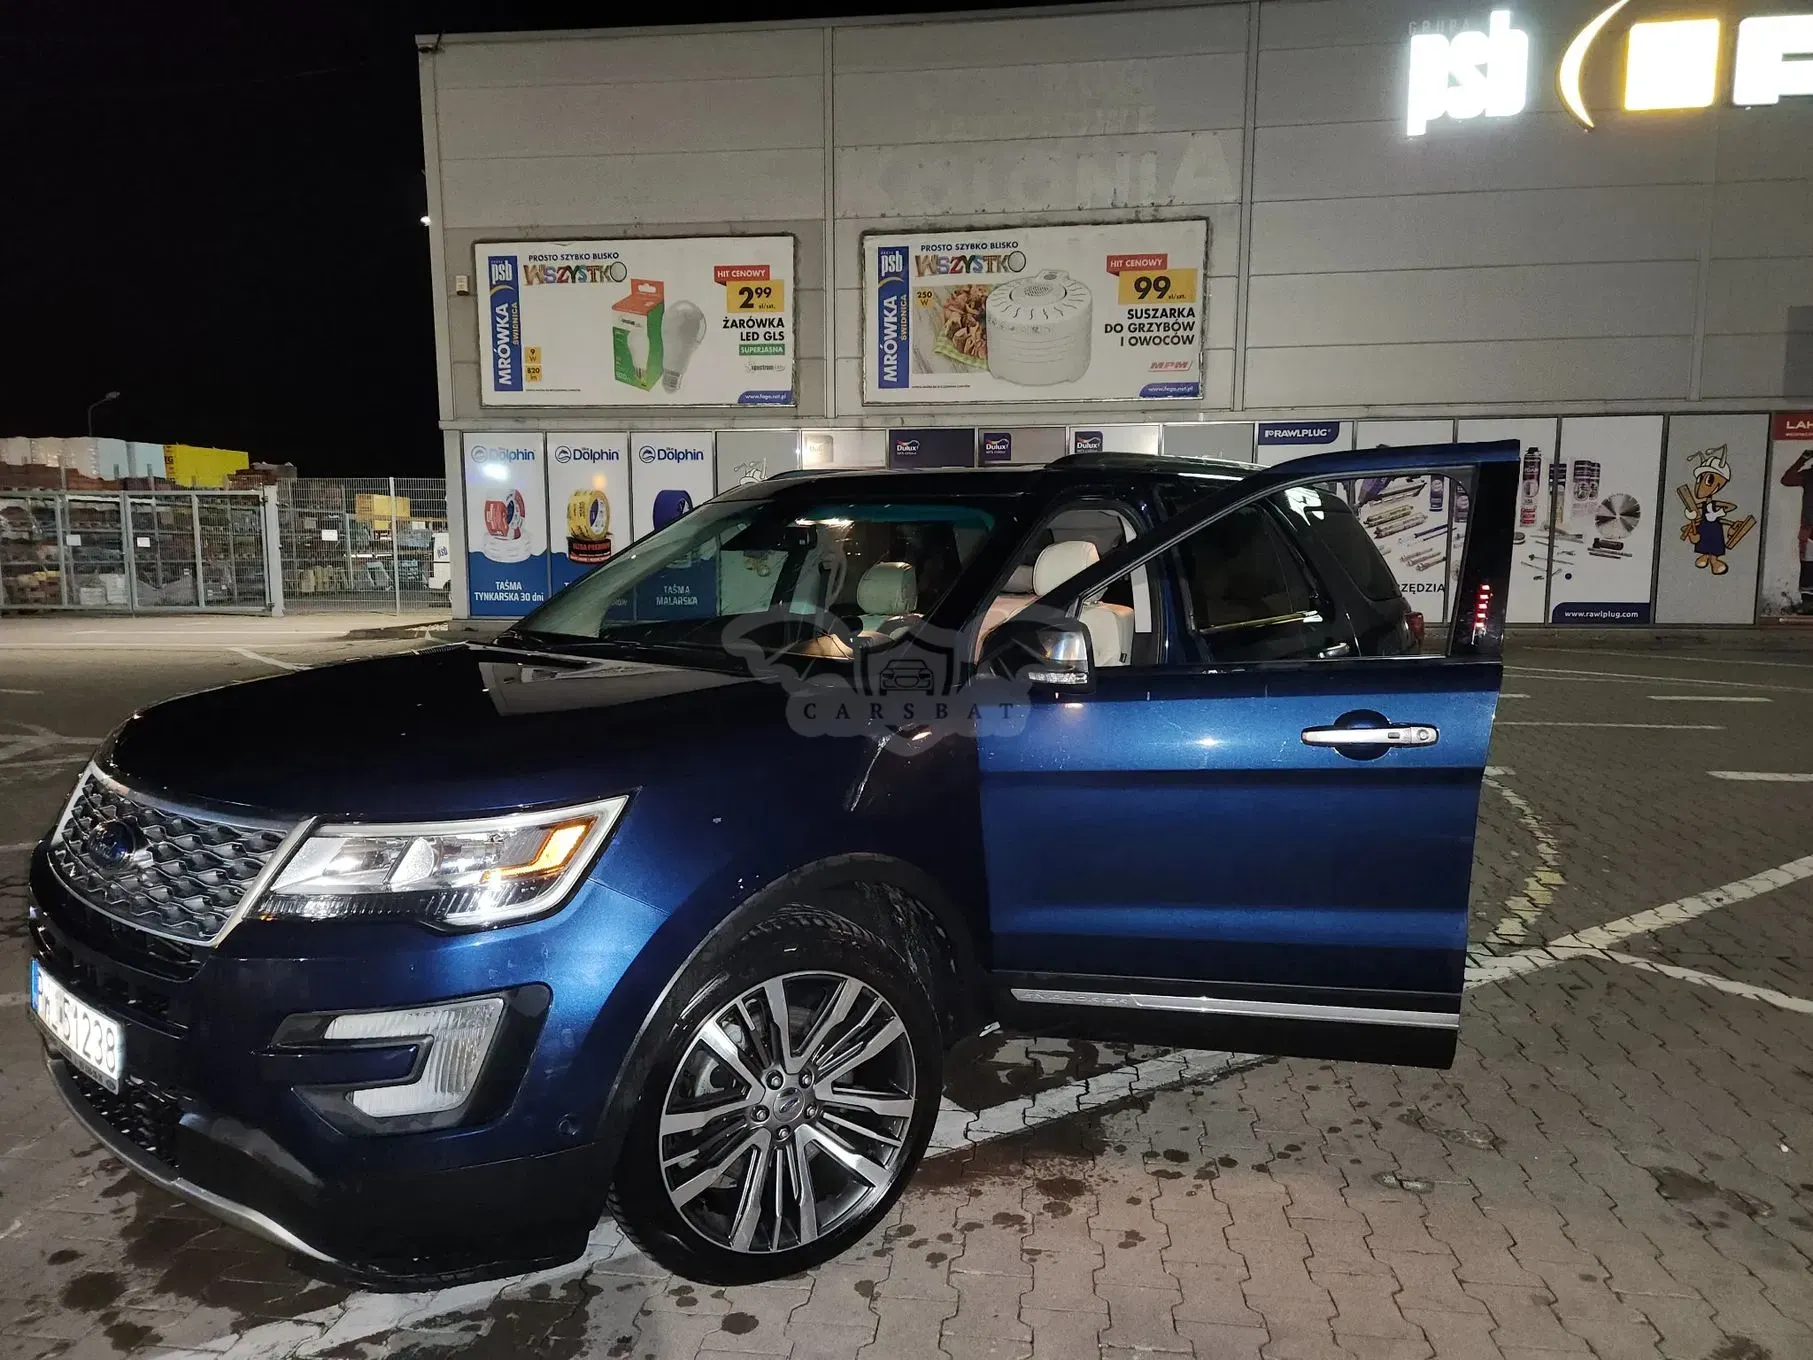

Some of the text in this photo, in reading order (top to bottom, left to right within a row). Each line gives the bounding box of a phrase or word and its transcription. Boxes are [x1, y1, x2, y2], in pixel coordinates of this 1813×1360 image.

[1407, 10, 1528, 136] psb
[921, 244, 952, 252] PROSTO
[990, 241, 1019, 249] BLISKO
[528, 254, 559, 262] PROSTO
[592, 252, 620, 260] BLISKO
[881, 250, 903, 277] psb
[1126, 259, 1162, 267] CENOWY
[915, 251, 1026, 277] WSZYSTKO
[491, 260, 513, 285] psb
[523, 261, 627, 286] WSZYSTKO
[717, 269, 766, 278] HIT CENOWY
[1134, 276, 1171, 300] 99
[917, 291, 933, 299] 250
[1127, 307, 1196, 320] SUSZARKA
[722, 316, 785, 329] ŻARÓWKA
[1104, 319, 1196, 334] DO GRZYBÓW
[741, 331, 785, 342] LED GLS
[880, 296, 898, 383] MRÓWKA
[1120, 332, 1195, 347] I OWOCÓW
[494, 303, 512, 385] MRÓWKA
[741, 345, 784, 354] SUPERJASNA
[1274, 429, 1328, 438] RAWLPLUG
[896, 444, 917, 452] Dulux
[573, 449, 619, 463] Dolphin
[657, 449, 704, 463] Dolphin
[495, 579, 522, 590] TAŚMA
[474, 592, 544, 601] TYNKARSKA 30 dni
[656, 597, 698, 605] MALARSKA
[1564, 610, 1638, 619] www.rawlplug.com
